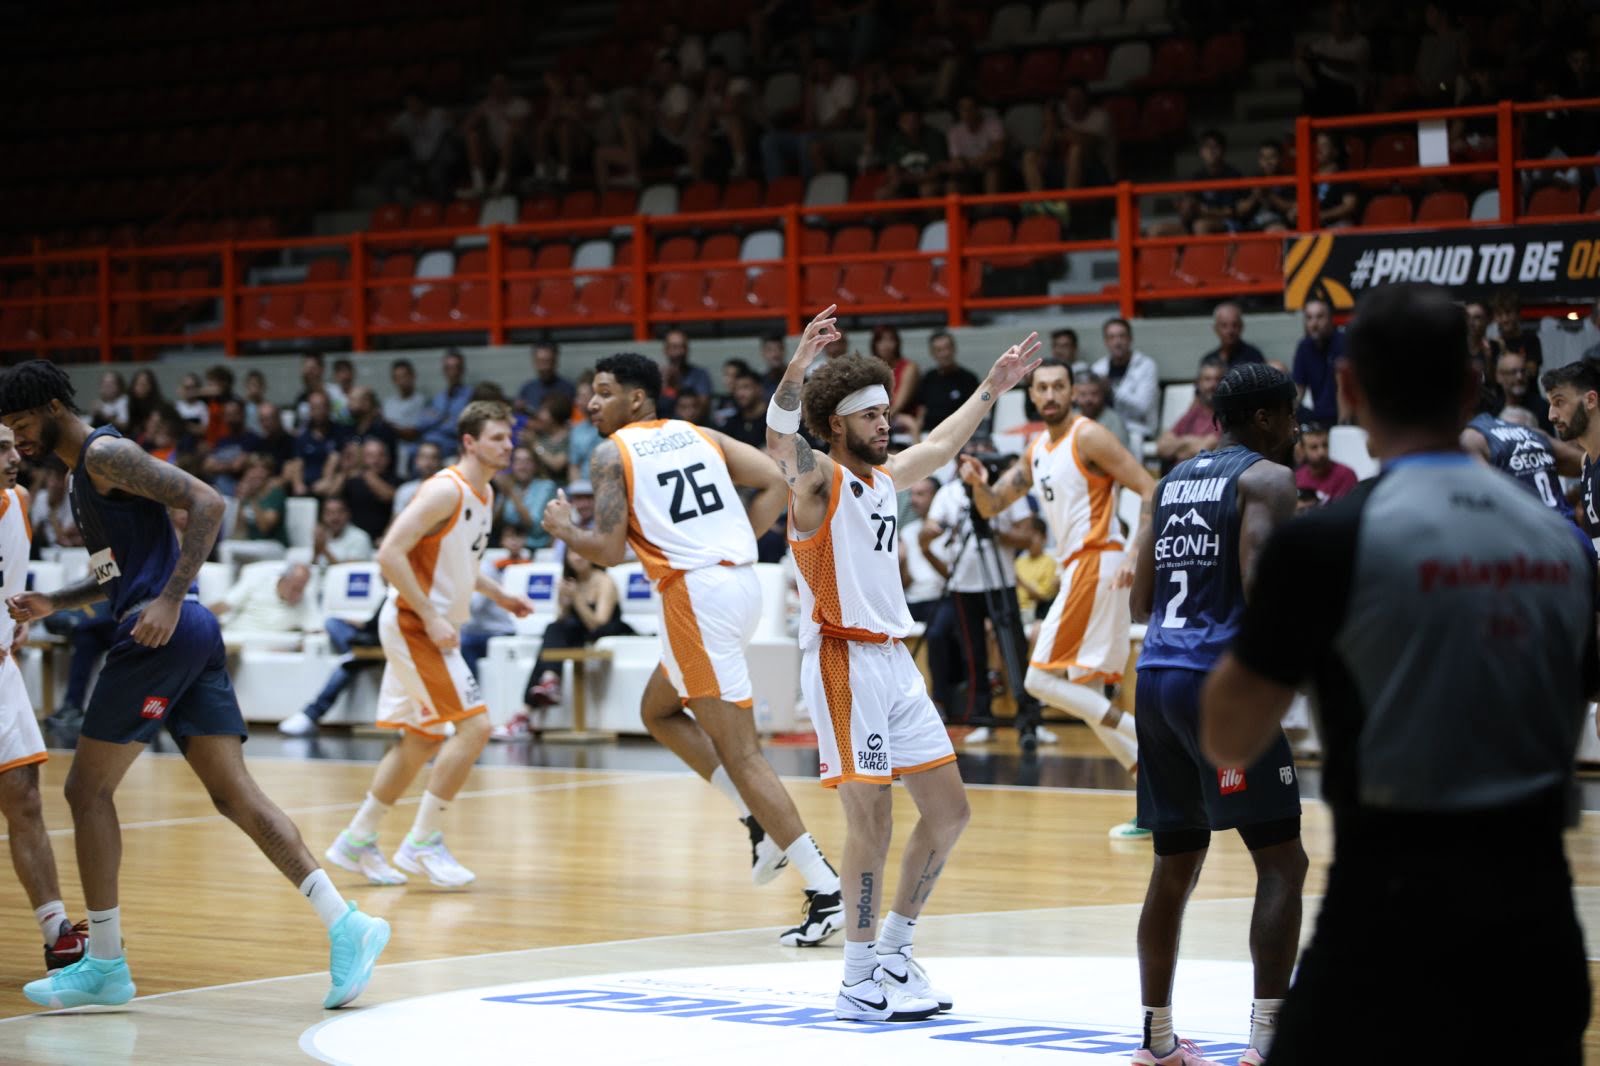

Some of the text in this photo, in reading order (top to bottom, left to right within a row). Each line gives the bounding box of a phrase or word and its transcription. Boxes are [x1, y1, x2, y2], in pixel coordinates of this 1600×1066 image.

[1351, 245, 1474, 289] #PROUD
[1476, 243, 1516, 285] TO
[1519, 240, 1564, 283] BE
[656, 462, 725, 524] 26
[1160, 476, 1229, 507] BUCHANAN
[1534, 471, 1558, 508] 0
[870, 512, 897, 553] 77
[1160, 570, 1188, 629] 2
[143, 700, 165, 717] illy
[858, 760, 889, 771] CARGO
[1220, 768, 1244, 792] illy
